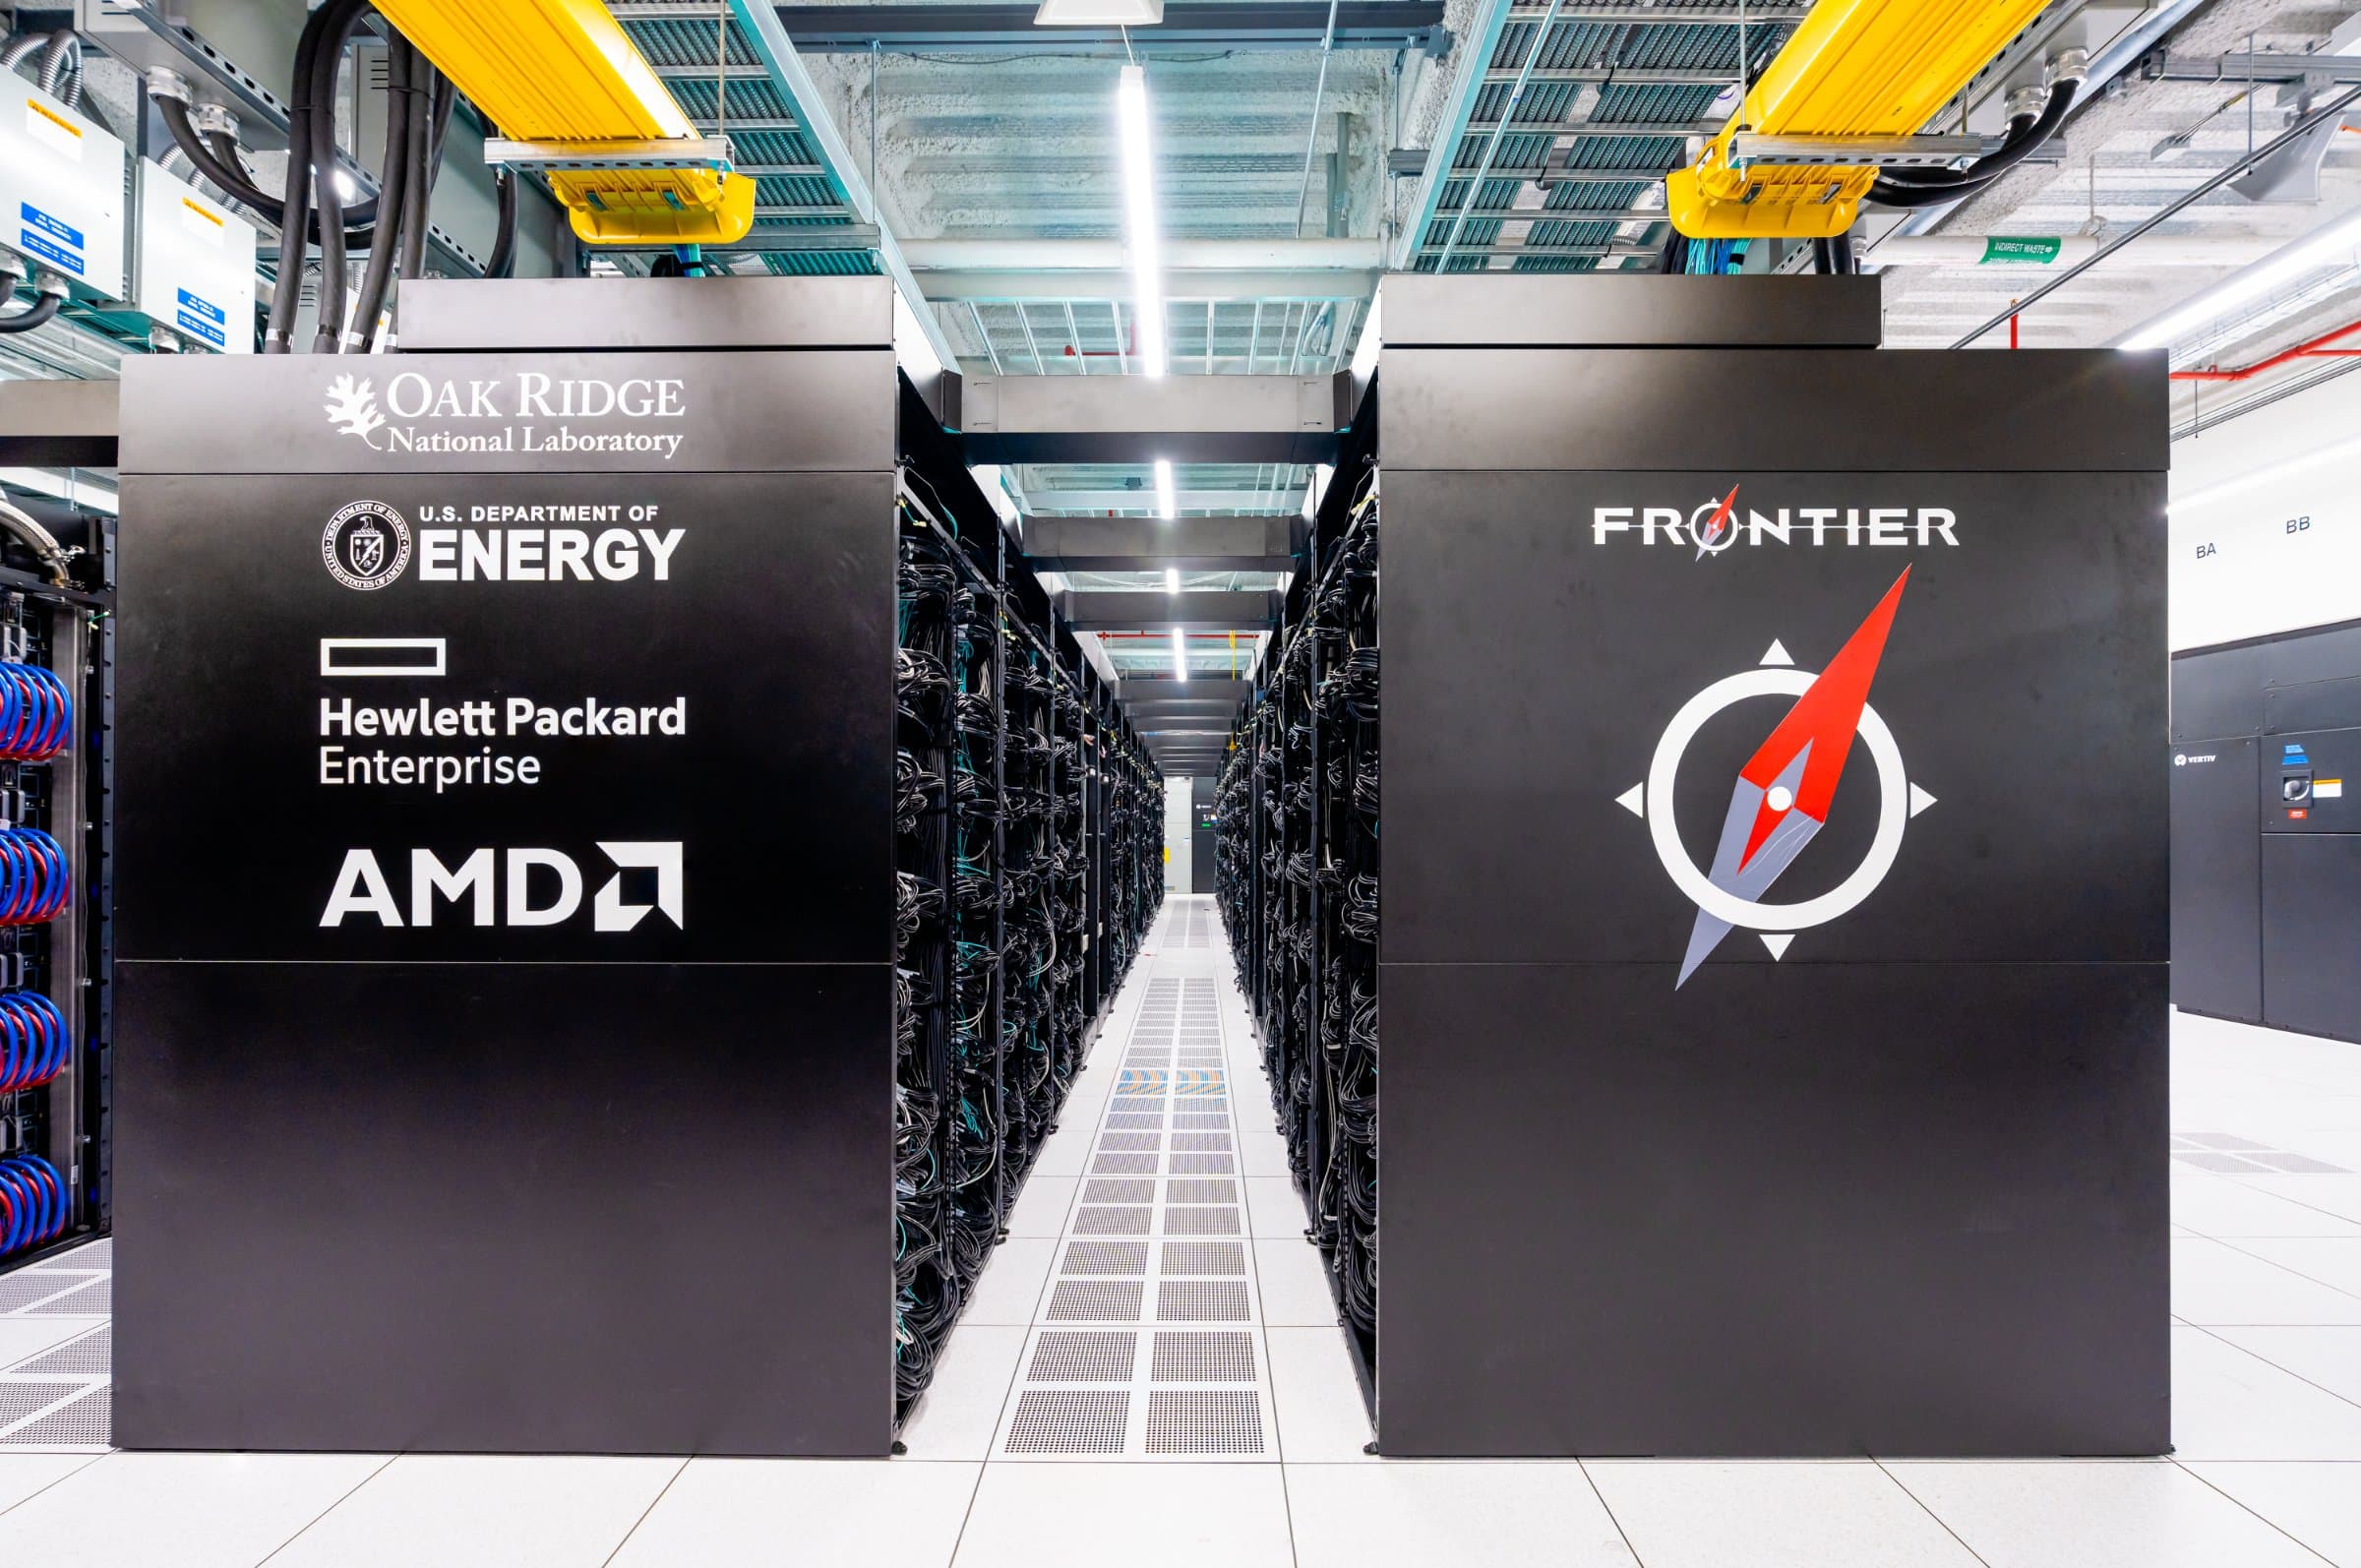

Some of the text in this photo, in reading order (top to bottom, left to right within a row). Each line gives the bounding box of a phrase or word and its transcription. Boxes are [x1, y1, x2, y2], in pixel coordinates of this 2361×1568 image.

[1994, 242, 2045, 254] INDIRECT WASTE
[387, 372, 687, 417] OAK RIDGE
[387, 426, 684, 459] National Laboratory
[325, 504, 408, 542] DEPARTMENT OF ENERGY
[419, 505, 658, 522] U.S. DEPARTMENT OF
[1593, 503, 1961, 551] FRONTIER
[2286, 515, 2310, 534] BB
[325, 545, 409, 588] UNITED STATES OF AMERICA
[419, 527, 687, 581] ENERGY
[2196, 542, 2216, 559] BA
[320, 696, 686, 736] Hewlett Packard
[320, 746, 541, 794] Enterprise
[319, 849, 583, 927] AMD
